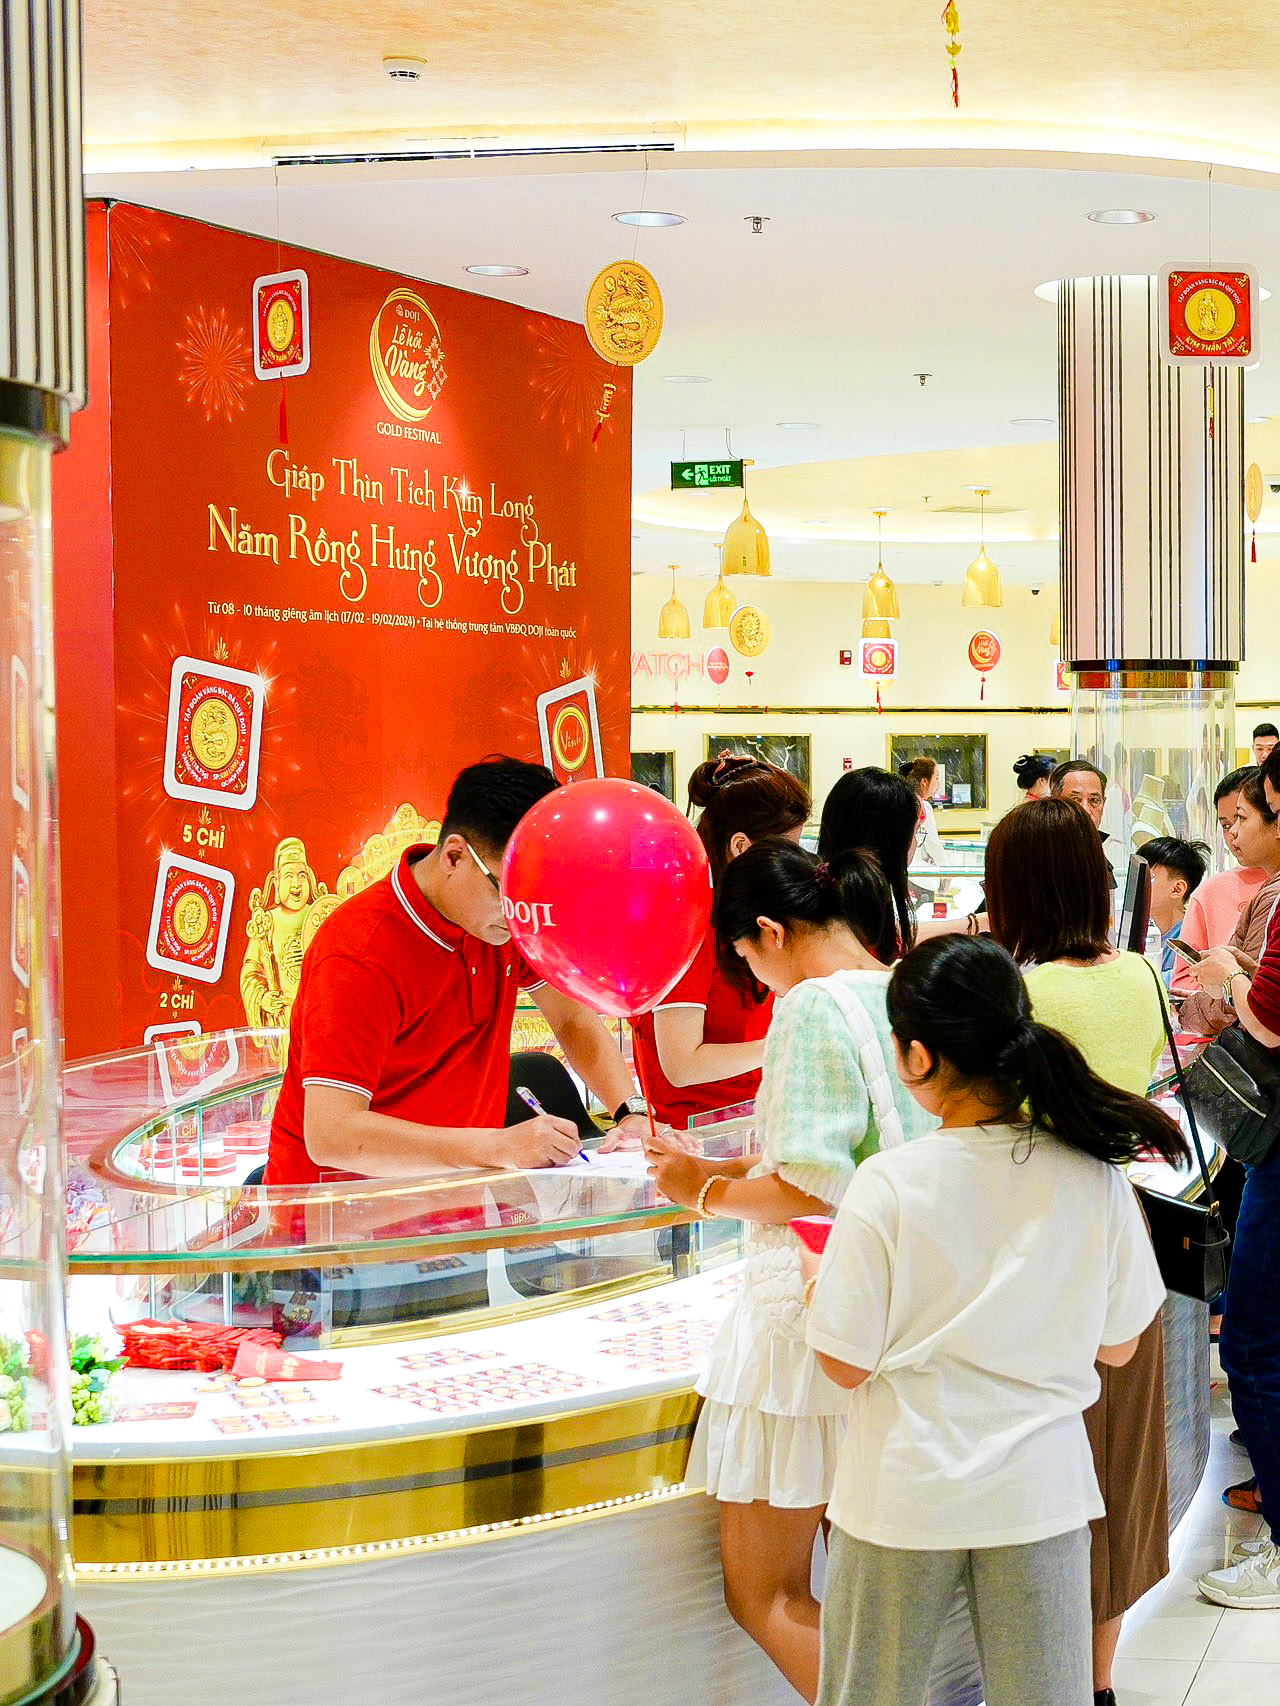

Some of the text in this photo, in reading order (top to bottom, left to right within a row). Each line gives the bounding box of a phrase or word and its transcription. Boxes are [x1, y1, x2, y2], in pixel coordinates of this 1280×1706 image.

[404, 309, 420, 323] DOJI
[392, 323, 423, 353] Lễ hội
[384, 344, 429, 397] Vàng
[377, 422, 442, 445] GOLD FESTIVAL
[709, 465, 731, 474] EXIT
[267, 449, 539, 546] Giáp Thìn Tích Kim Long
[208, 503, 577, 615] Năm Rồng Hưng Vượng Phát
[208, 601, 221, 614] Từ
[221, 602, 235, 615] 08
[243, 604, 253, 616] 10
[254, 604, 281, 622] tháng
[282, 607, 308, 623] giêng
[309, 609, 323, 621] âm
[324, 609, 339, 624] lịch
[421, 616, 433, 631] Tại
[434, 617, 445, 632] hệ
[445, 617, 468, 634] thống
[468, 621, 489, 635] trung
[490, 622, 504, 633] tâm
[528, 625, 544, 638] DOJI
[544, 626, 560, 638] toàn
[560, 626, 577, 640] quốc
[631, 651, 704, 676] ATCH
[183, 824, 226, 849] 5 CHỈ
[503, 896, 557, 935] DOJI
[160, 990, 195, 1011] 2 CHỈ
